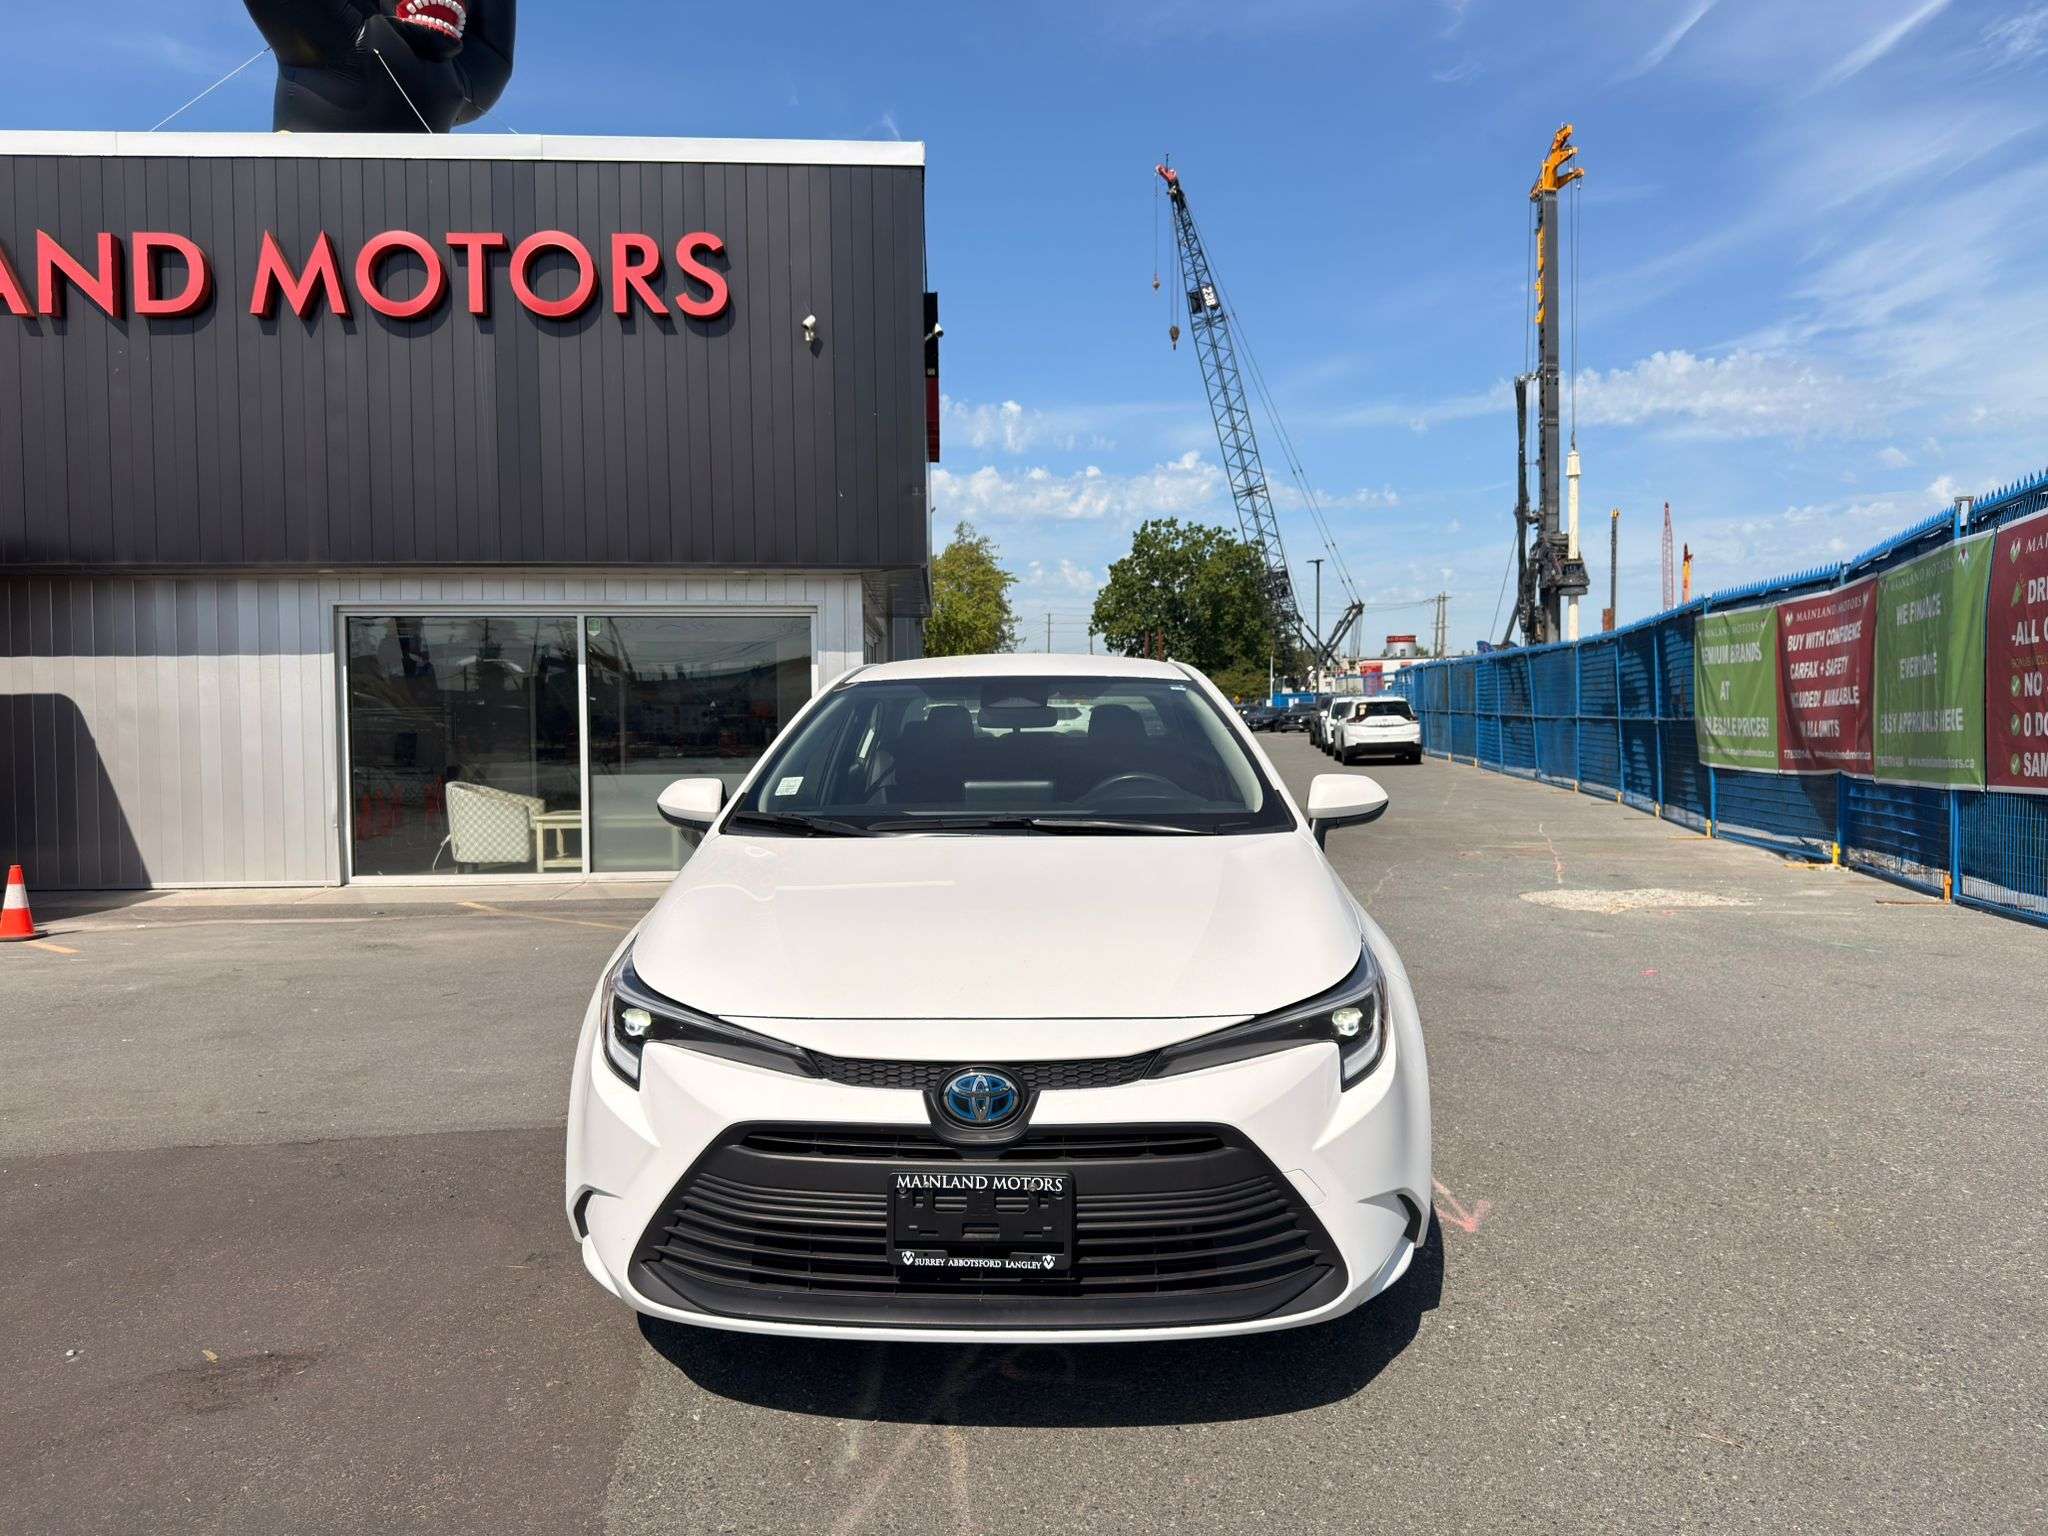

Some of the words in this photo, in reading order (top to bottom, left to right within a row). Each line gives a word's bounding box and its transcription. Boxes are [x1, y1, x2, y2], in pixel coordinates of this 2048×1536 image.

[250, 229, 735, 319] MOTORS
[2027, 576, 2048, 605] DR
[1787, 633, 1805, 652] BUY
[1805, 630, 1826, 650] WITH
[1790, 661, 1819, 680] CARFAX
[1825, 655, 1850, 677] SAFETY
[1720, 680, 1731, 701] AT
[2024, 671, 2043, 697] NO
[896, 1175, 988, 1190] MAINLAND
[993, 1177, 1063, 1192] MOTORS
[914, 1258, 945, 1267] SURREY
[948, 1259, 1001, 1268] ABBOTSFORD
[1005, 1261, 1042, 1270] LANGLEY
